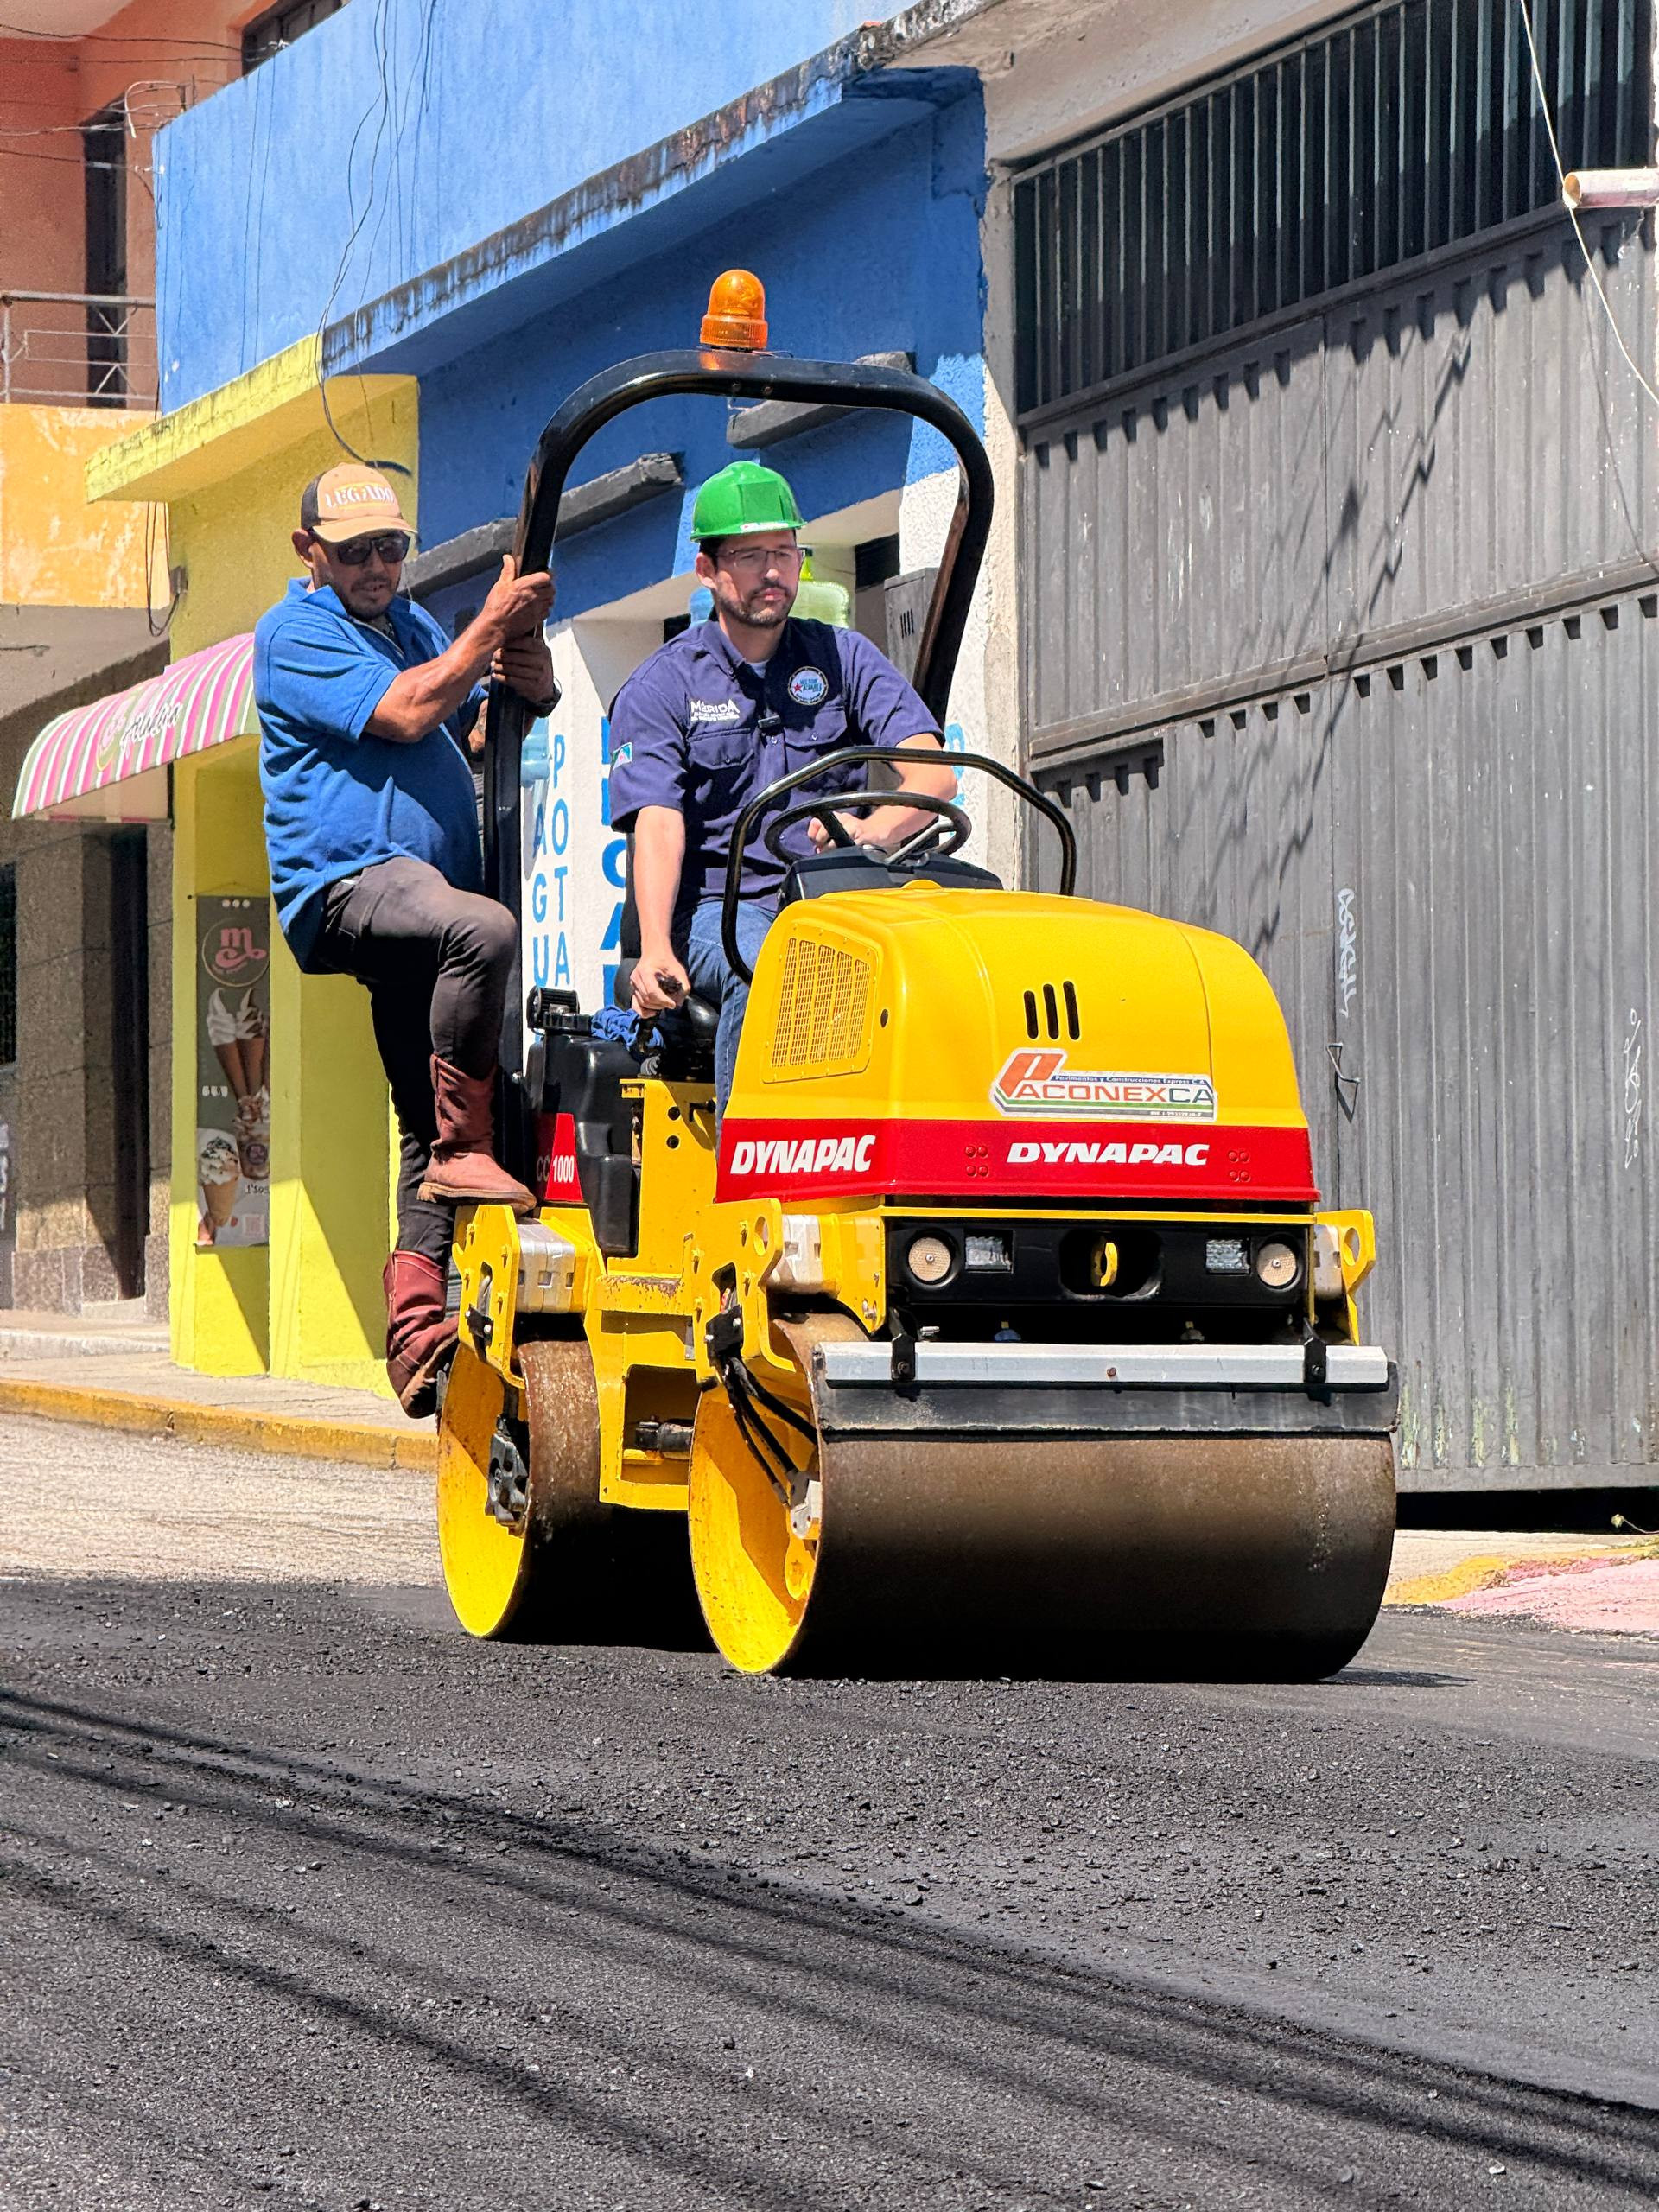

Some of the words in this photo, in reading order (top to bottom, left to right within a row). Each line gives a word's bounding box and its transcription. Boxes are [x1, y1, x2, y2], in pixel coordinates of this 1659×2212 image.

[324, 485, 395, 509] LEGADO
[730, 1134, 876, 1174] DYNAPAC
[1007, 1142, 1210, 1166] DYNAPAC
[536, 1155, 550, 1183] CC
[552, 1154, 575, 1184] 1000
